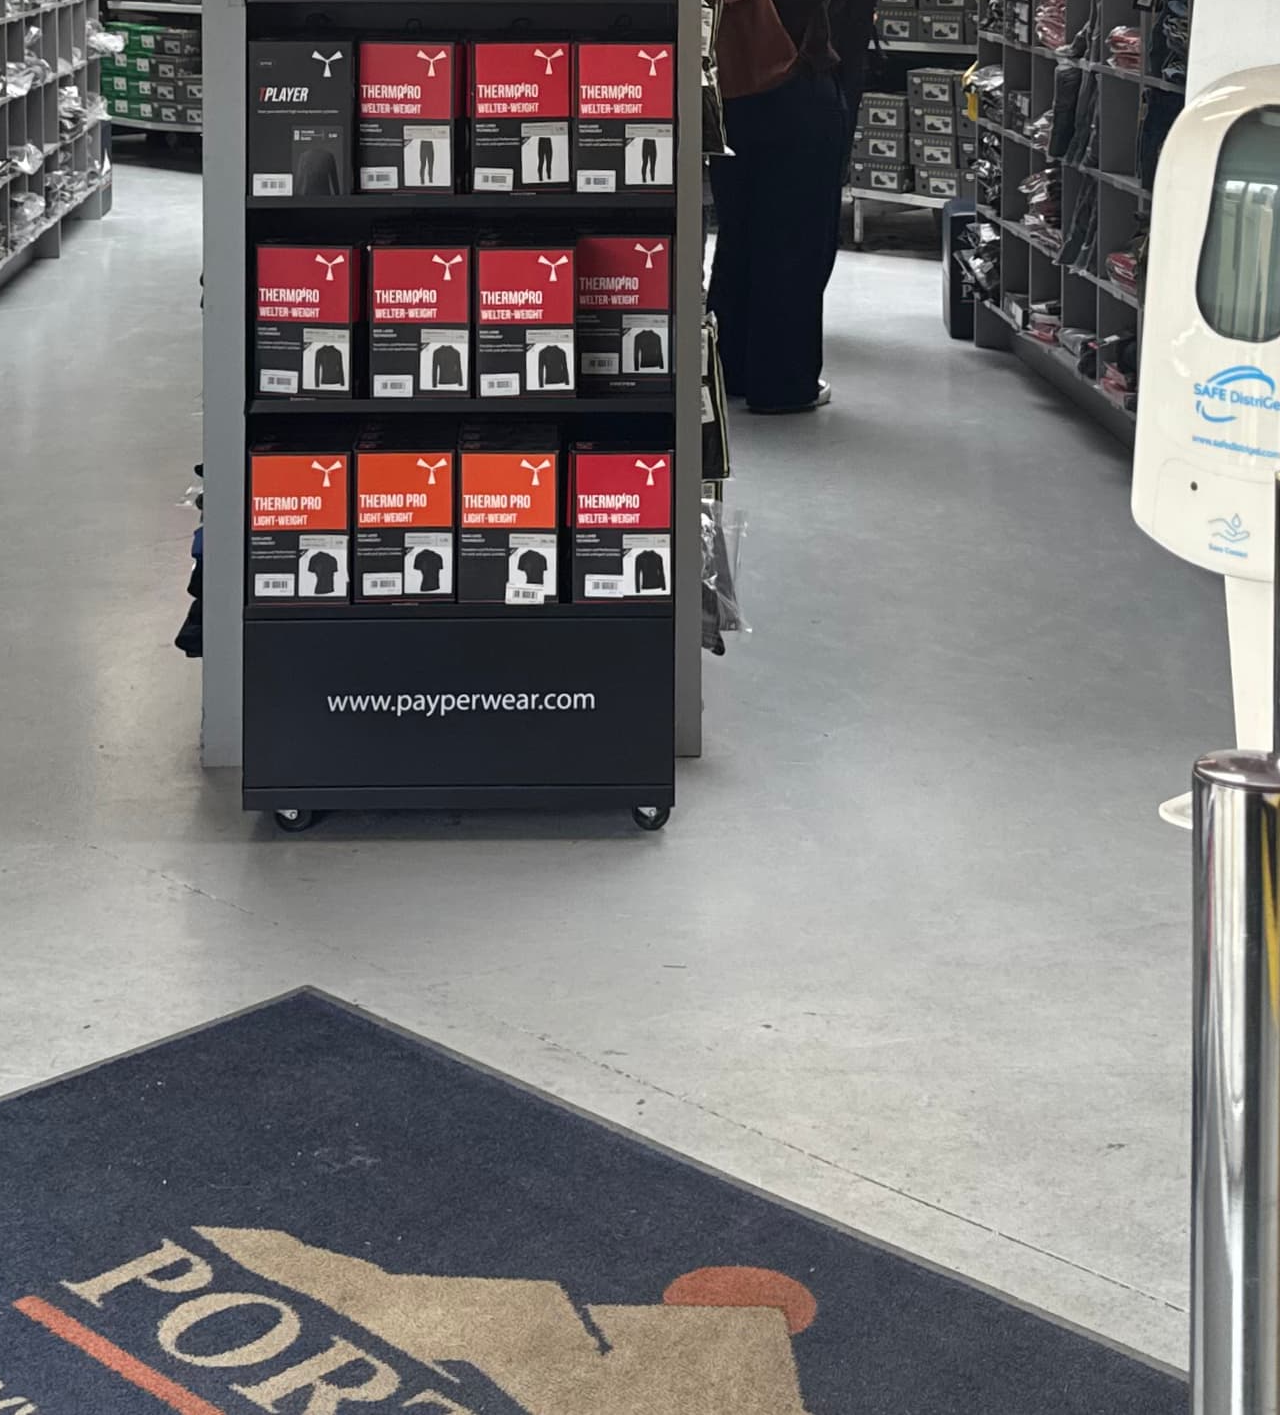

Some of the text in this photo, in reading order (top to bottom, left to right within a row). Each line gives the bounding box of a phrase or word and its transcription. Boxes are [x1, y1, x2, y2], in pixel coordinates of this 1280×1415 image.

[360, 103, 422, 114] WELTER-WEIGHT
[477, 102, 539, 114] WELTER-WEIGHT
[580, 103, 643, 115] WELTER-WEIGHT
[258, 306, 320, 319] WELTER-WEIGHT
[375, 307, 438, 319] WELTER-WEIGHT
[480, 309, 544, 320] WELTER-WEIGHT
[1193, 383, 1227, 402] SAFE
[253, 496, 322, 512] THERMO PRO
[359, 493, 428, 509] THERMO PRO
[463, 494, 531, 509] THERMO PRO
[253, 514, 308, 526] LIGHT-WEIGHT
[359, 511, 414, 524] LIGHT-WEIGHT
[463, 512, 518, 524] LIGHT-WEIGHT
[578, 512, 641, 524] WELTER-WEIGHT
[326, 691, 597, 717] www.payperwear.com
[58, 1237, 478, 1415] POR
